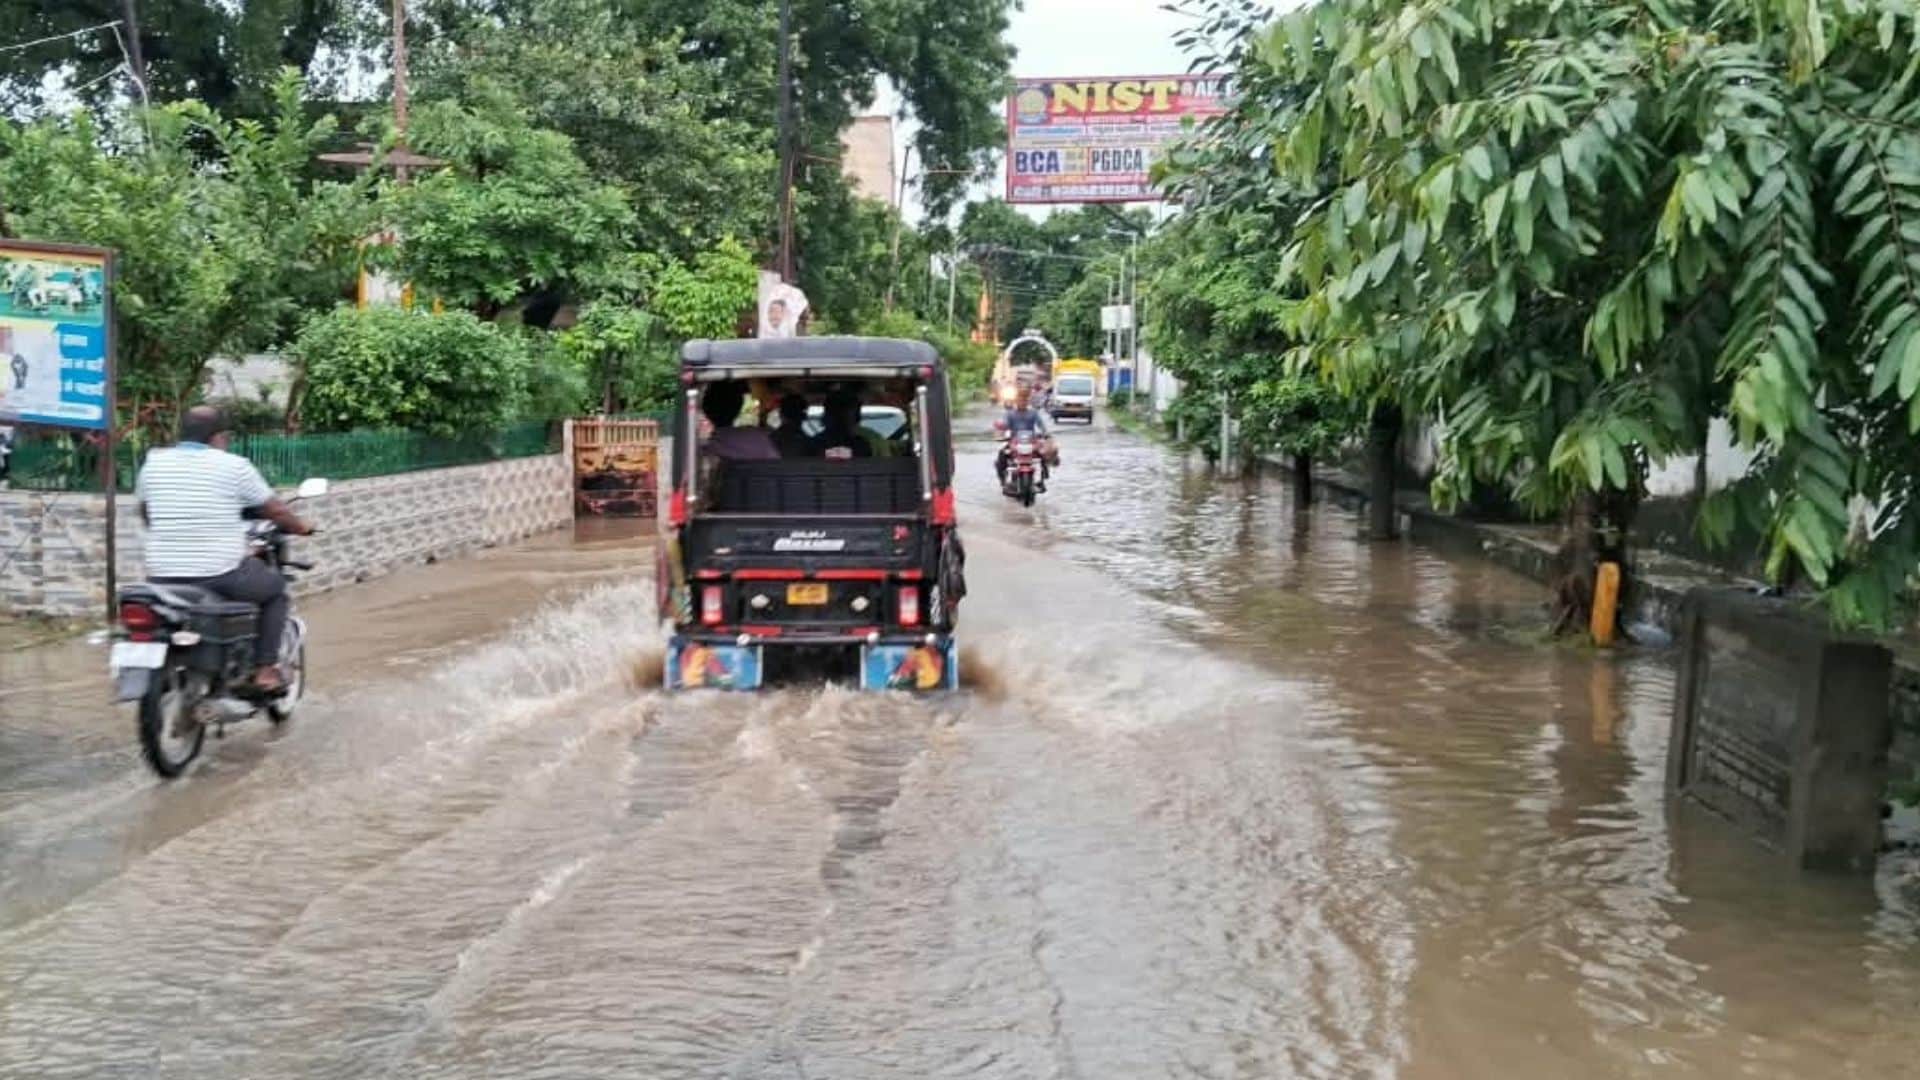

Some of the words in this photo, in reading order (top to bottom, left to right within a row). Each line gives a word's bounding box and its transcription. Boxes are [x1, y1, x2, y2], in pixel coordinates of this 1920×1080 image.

[1052, 81, 1178, 113] NIST
[1015, 151, 1060, 173] BCA
[1092, 149, 1143, 171] PGDCA
